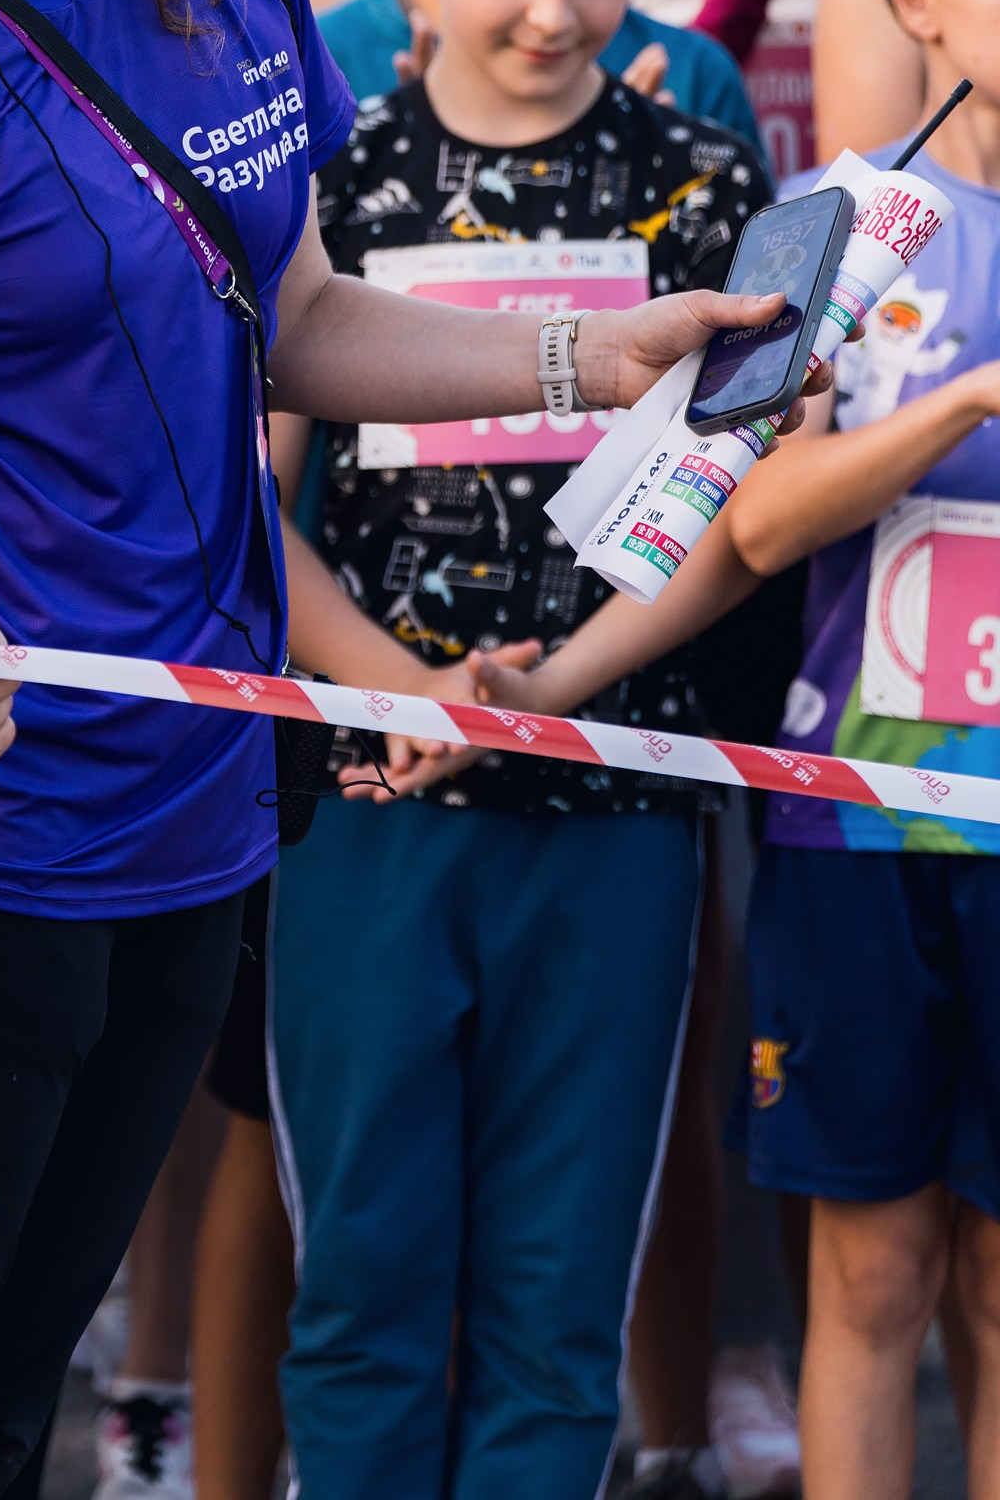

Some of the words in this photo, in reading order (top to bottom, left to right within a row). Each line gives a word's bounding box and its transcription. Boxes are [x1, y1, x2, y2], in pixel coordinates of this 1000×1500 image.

[274, 51, 288, 67] 40
[187, 217, 197, 232] 40
[762, 220, 817, 252] 18:37
[836, 274, 870, 300] ГОЛУБОЙ
[723, 322, 772, 345] СПОРТ
[773, 315, 793, 328] 40
[697, 442, 712, 454] КМ
[684, 456, 703, 469] 18:40
[665, 482, 684, 495] 19:00
[675, 469, 694, 482] 18:50
[699, 480, 723, 502] СИНИЙ
[597, 481, 648, 545] СПОРТ
[649, 452, 668, 477] 40
[642, 508, 651, 519] 2
[647, 509, 665, 525] КМ
[635, 524, 656, 539] 19:10
[626, 538, 647, 553] 19:20
[237, 682, 258, 703] НЕ
[365, 700, 386, 721] PRO
[514, 724, 536, 744] НЕ
[643, 743, 664, 763] PRO
[792, 766, 815, 786] НЕ
[921, 785, 943, 805] PRO
